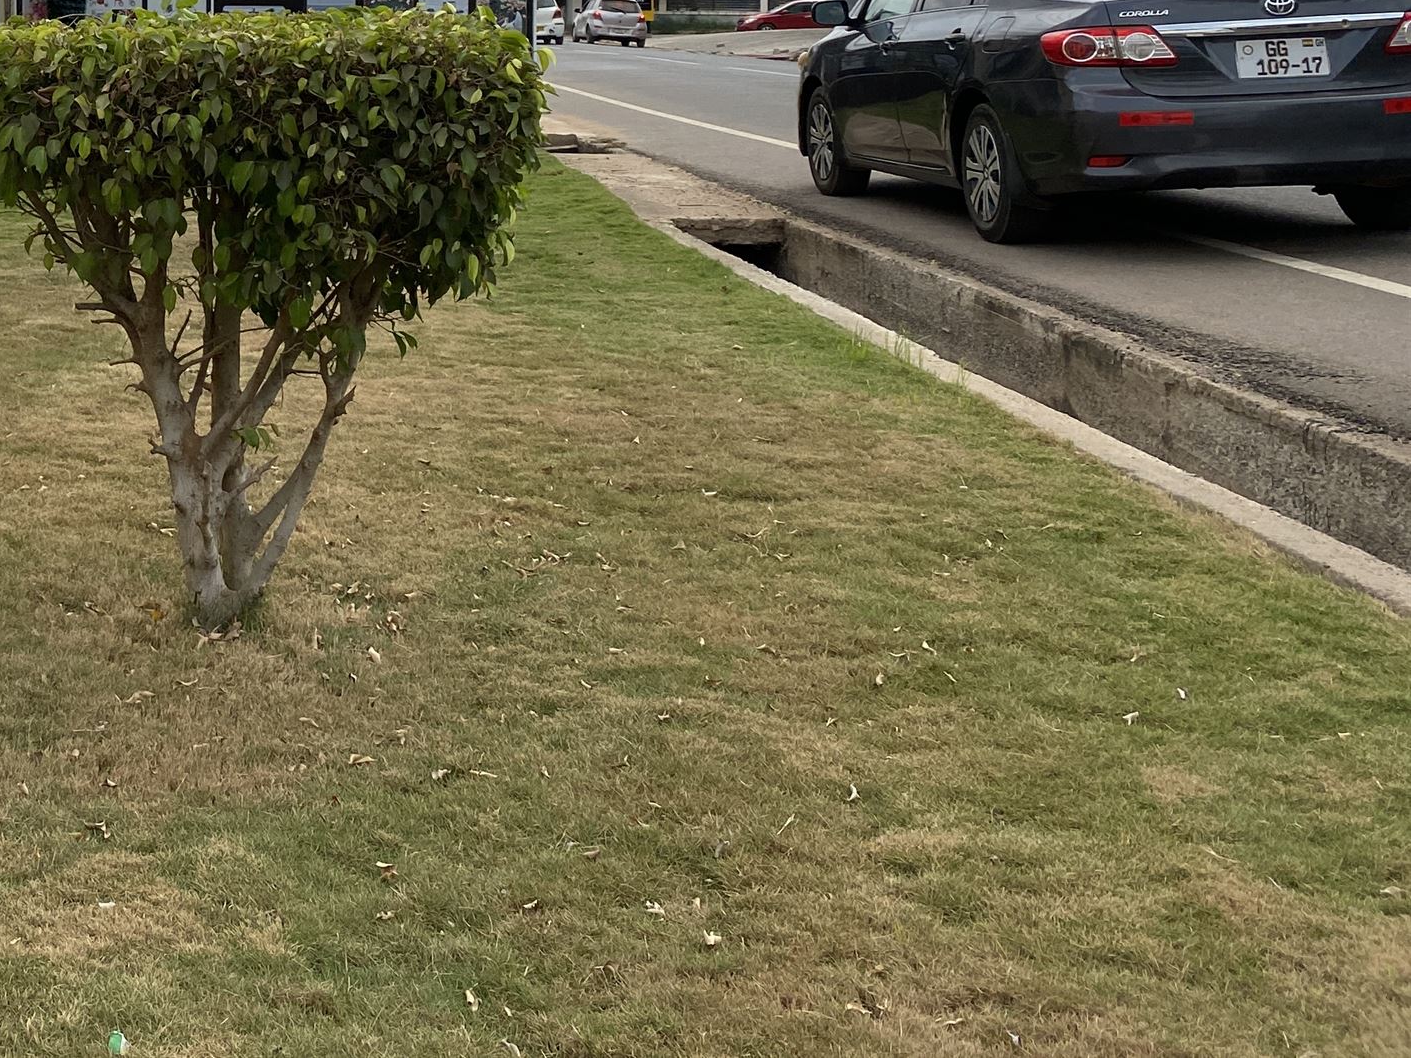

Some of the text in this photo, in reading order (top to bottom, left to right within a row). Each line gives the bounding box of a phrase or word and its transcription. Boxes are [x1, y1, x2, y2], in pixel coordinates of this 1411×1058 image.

[1118, 8, 1169, 18] COROLLA
[1265, 40, 1289, 57] GG
[1256, 57, 1323, 76] 109-17
